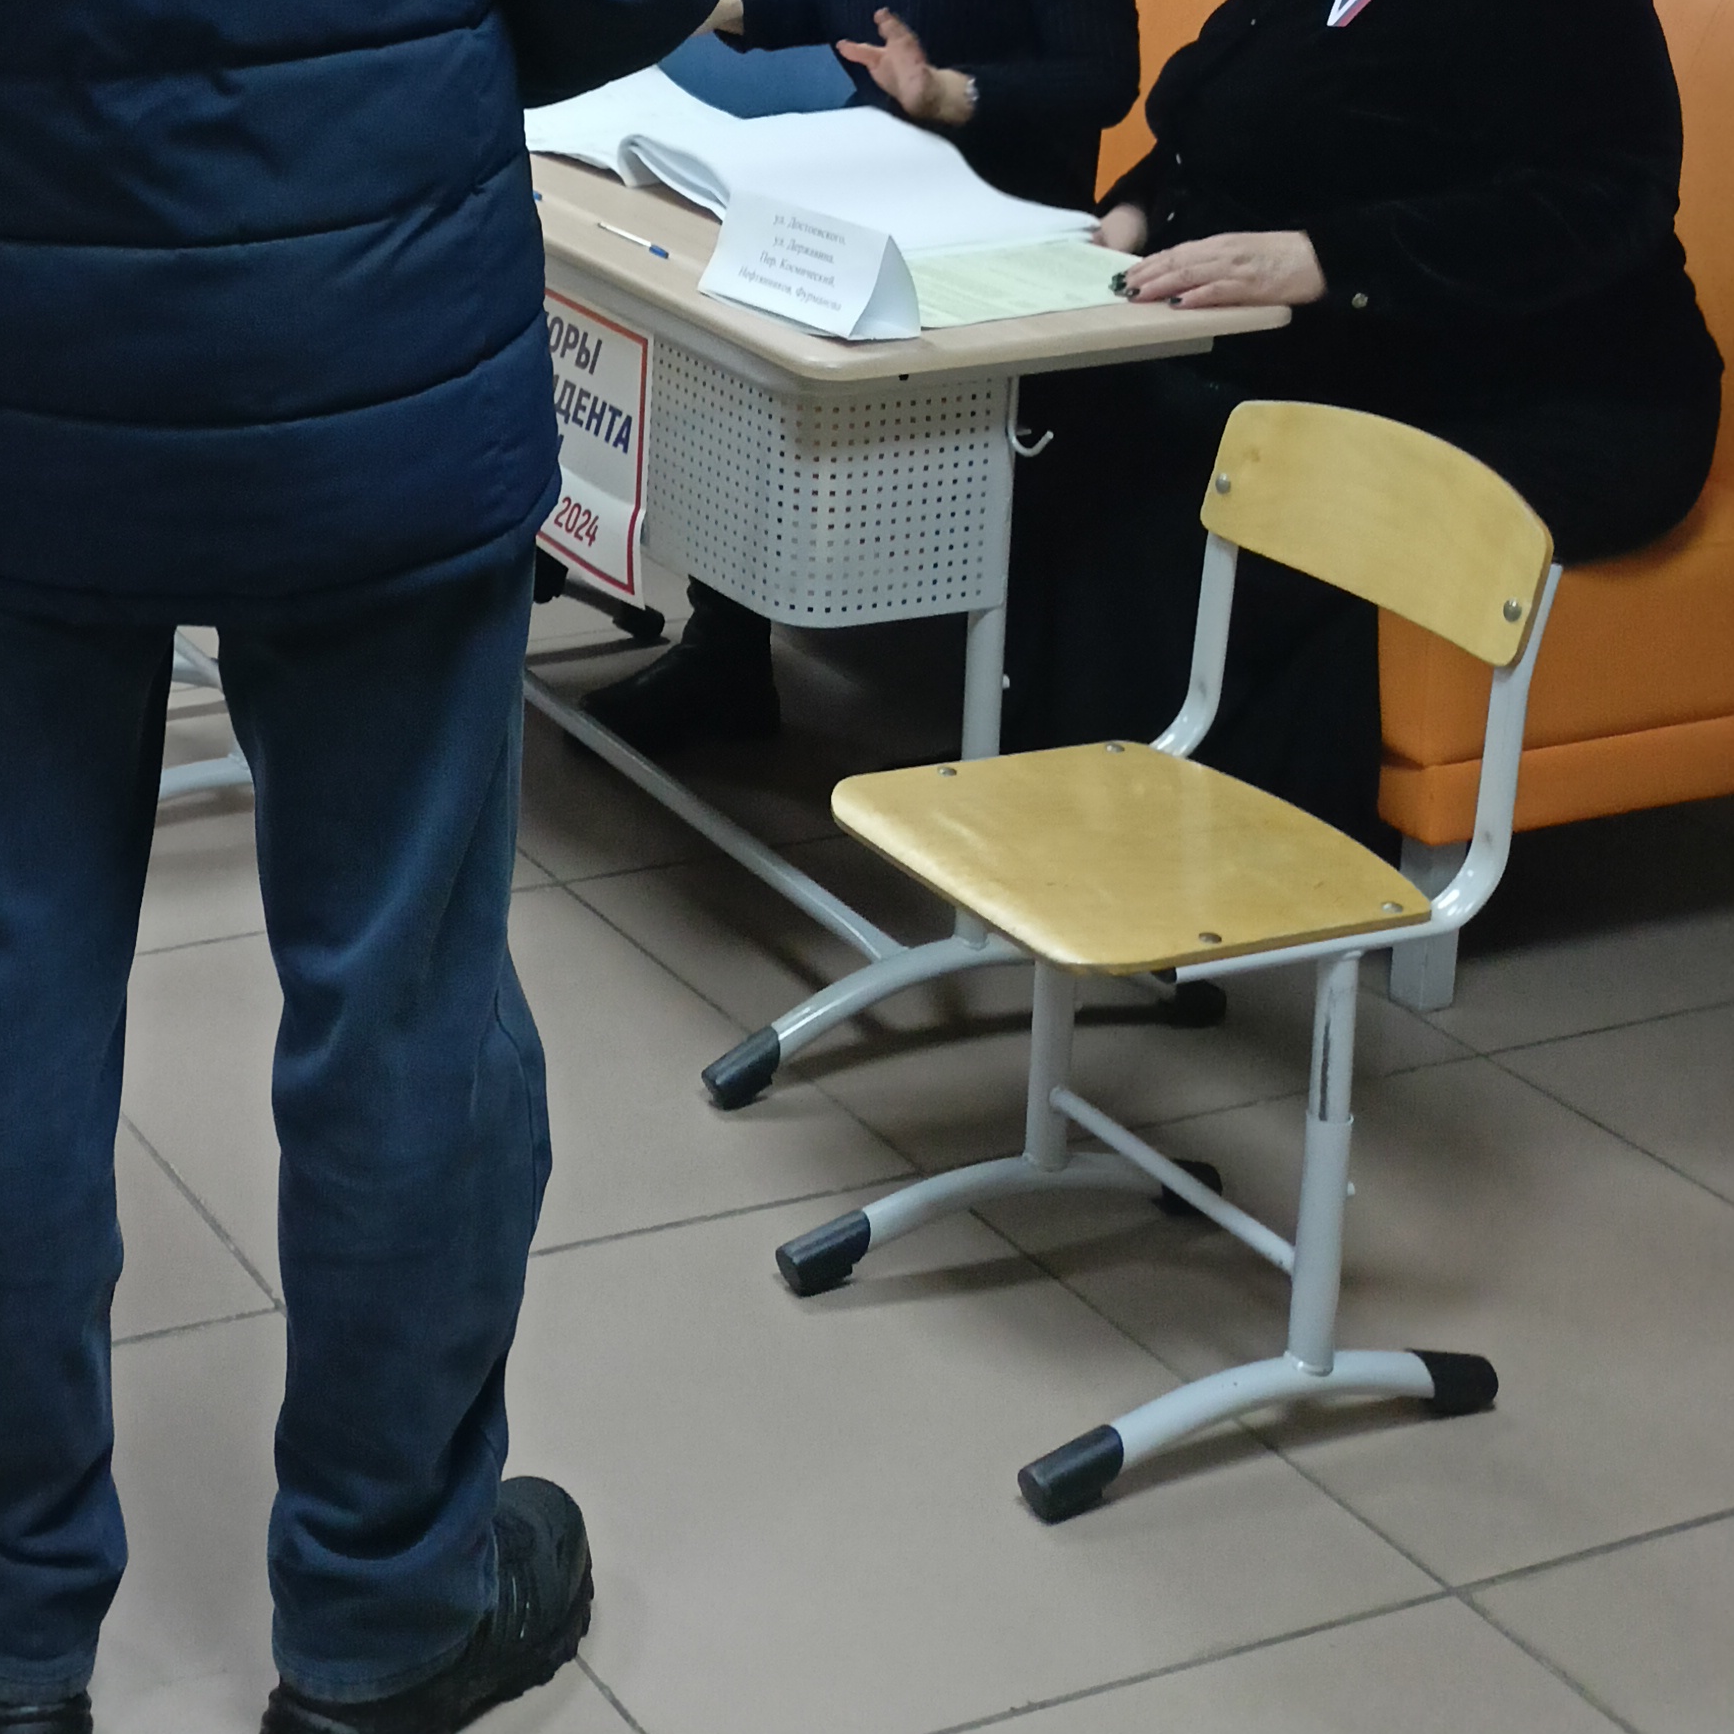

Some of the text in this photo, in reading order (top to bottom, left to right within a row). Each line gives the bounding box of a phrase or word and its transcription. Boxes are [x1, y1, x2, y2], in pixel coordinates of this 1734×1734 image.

[547, 314, 602, 375] ОРЫ
[553, 374, 633, 455] ДЕНТА
[553, 496, 600, 547] 2024
